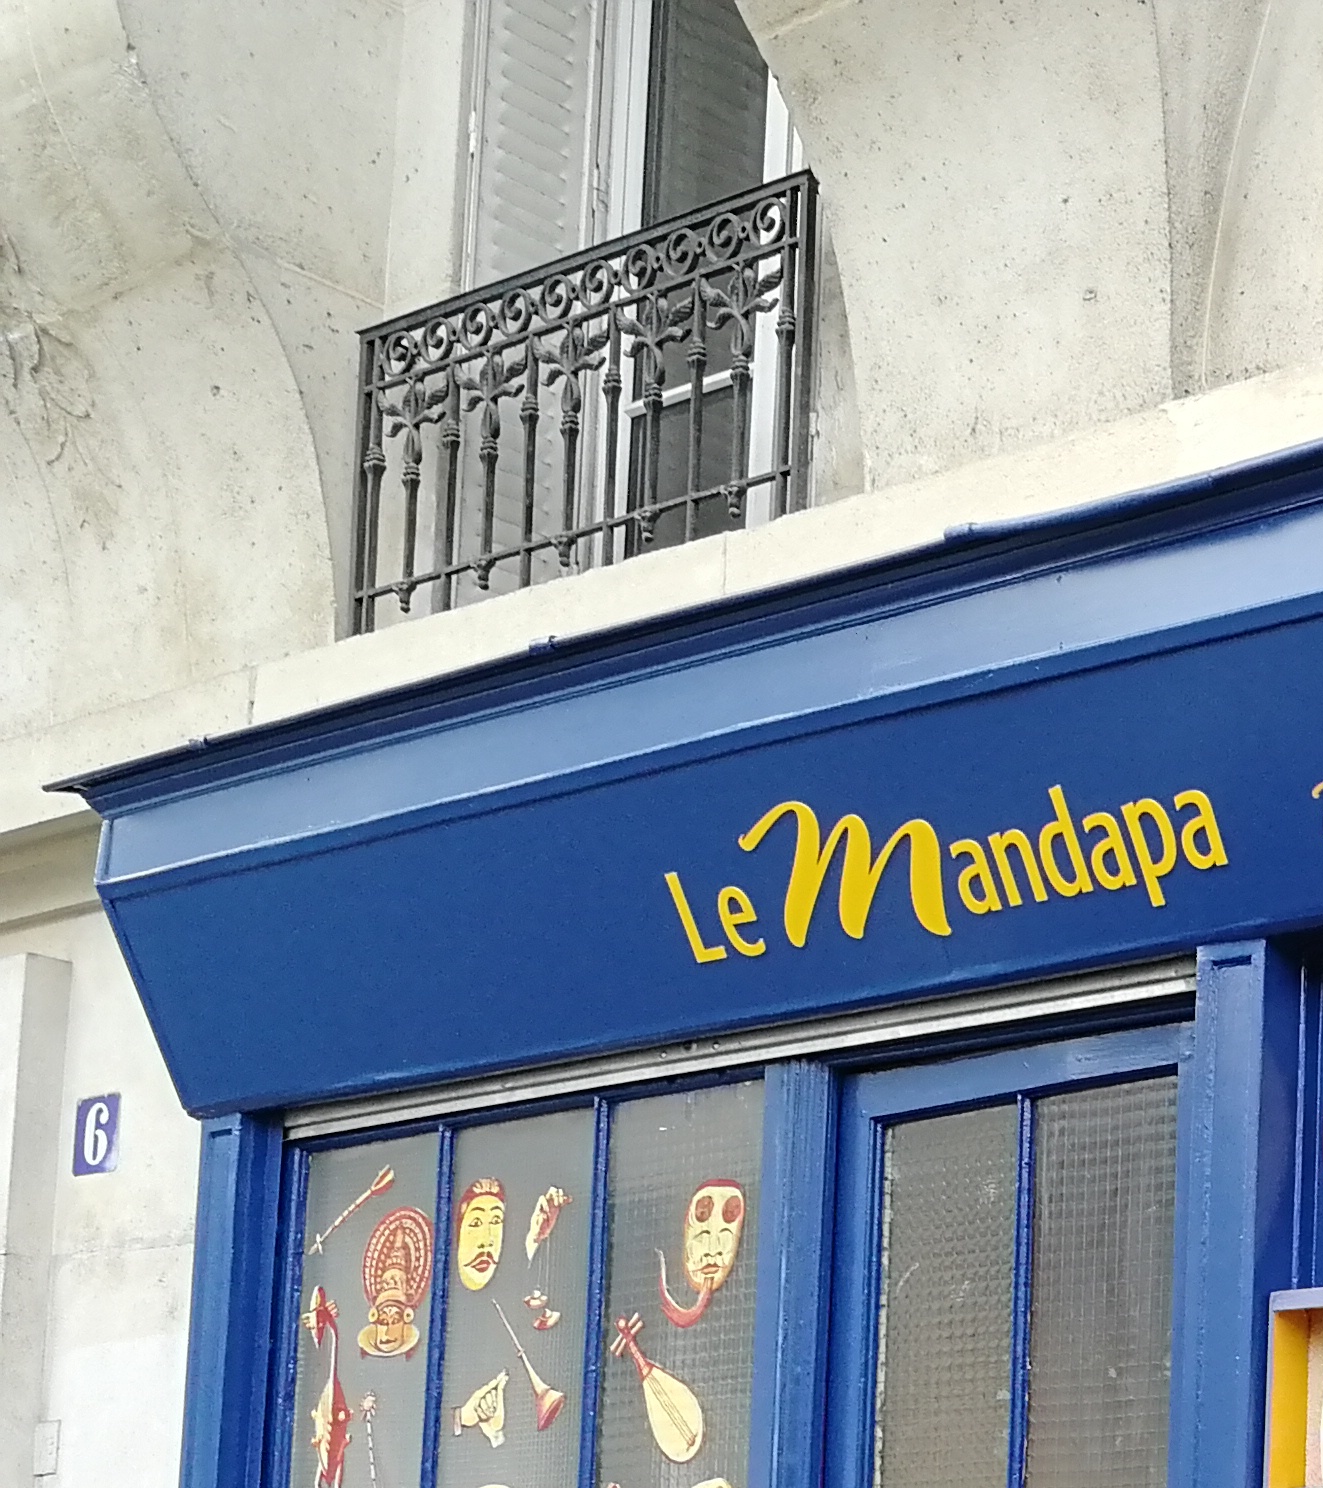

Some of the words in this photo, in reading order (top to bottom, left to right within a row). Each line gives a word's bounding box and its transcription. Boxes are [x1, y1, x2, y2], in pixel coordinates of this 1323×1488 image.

[664, 871, 766, 963] Le
[738, 784, 1229, 947] Mandapa
[84, 1102, 109, 1166] 6
